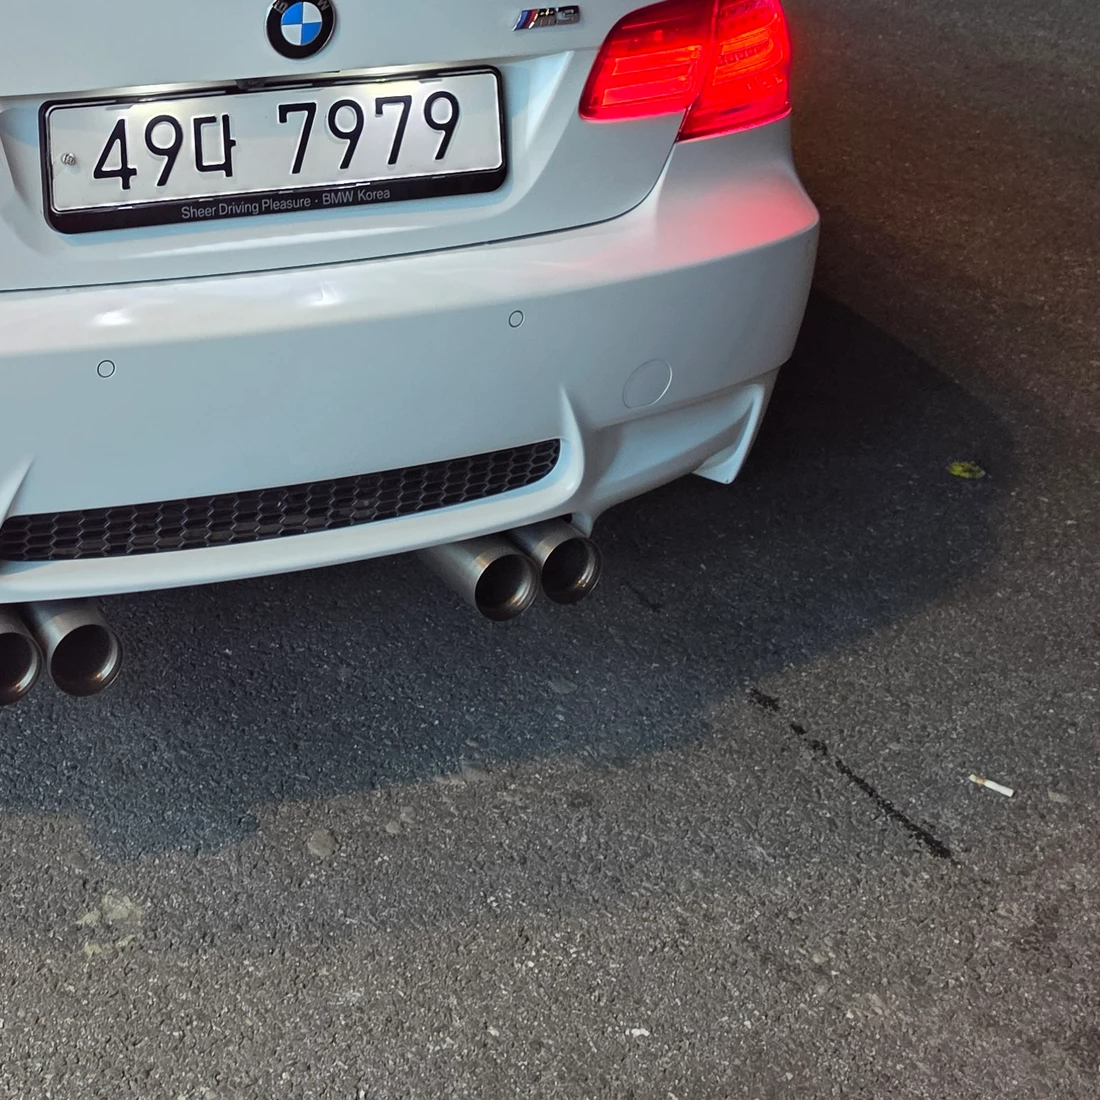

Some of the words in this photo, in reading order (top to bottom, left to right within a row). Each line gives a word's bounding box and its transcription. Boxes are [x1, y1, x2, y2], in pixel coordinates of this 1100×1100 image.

[520, 5, 581, 30] M3
[93, 113, 237, 190] 49다
[278, 90, 460, 175] 7979
[181, 206, 217, 219] Sheer
[219, 201, 259, 216] Driving
[261, 196, 311, 212] Pleasure
[322, 191, 354, 206] BMW
[357, 188, 391, 202] Korea
